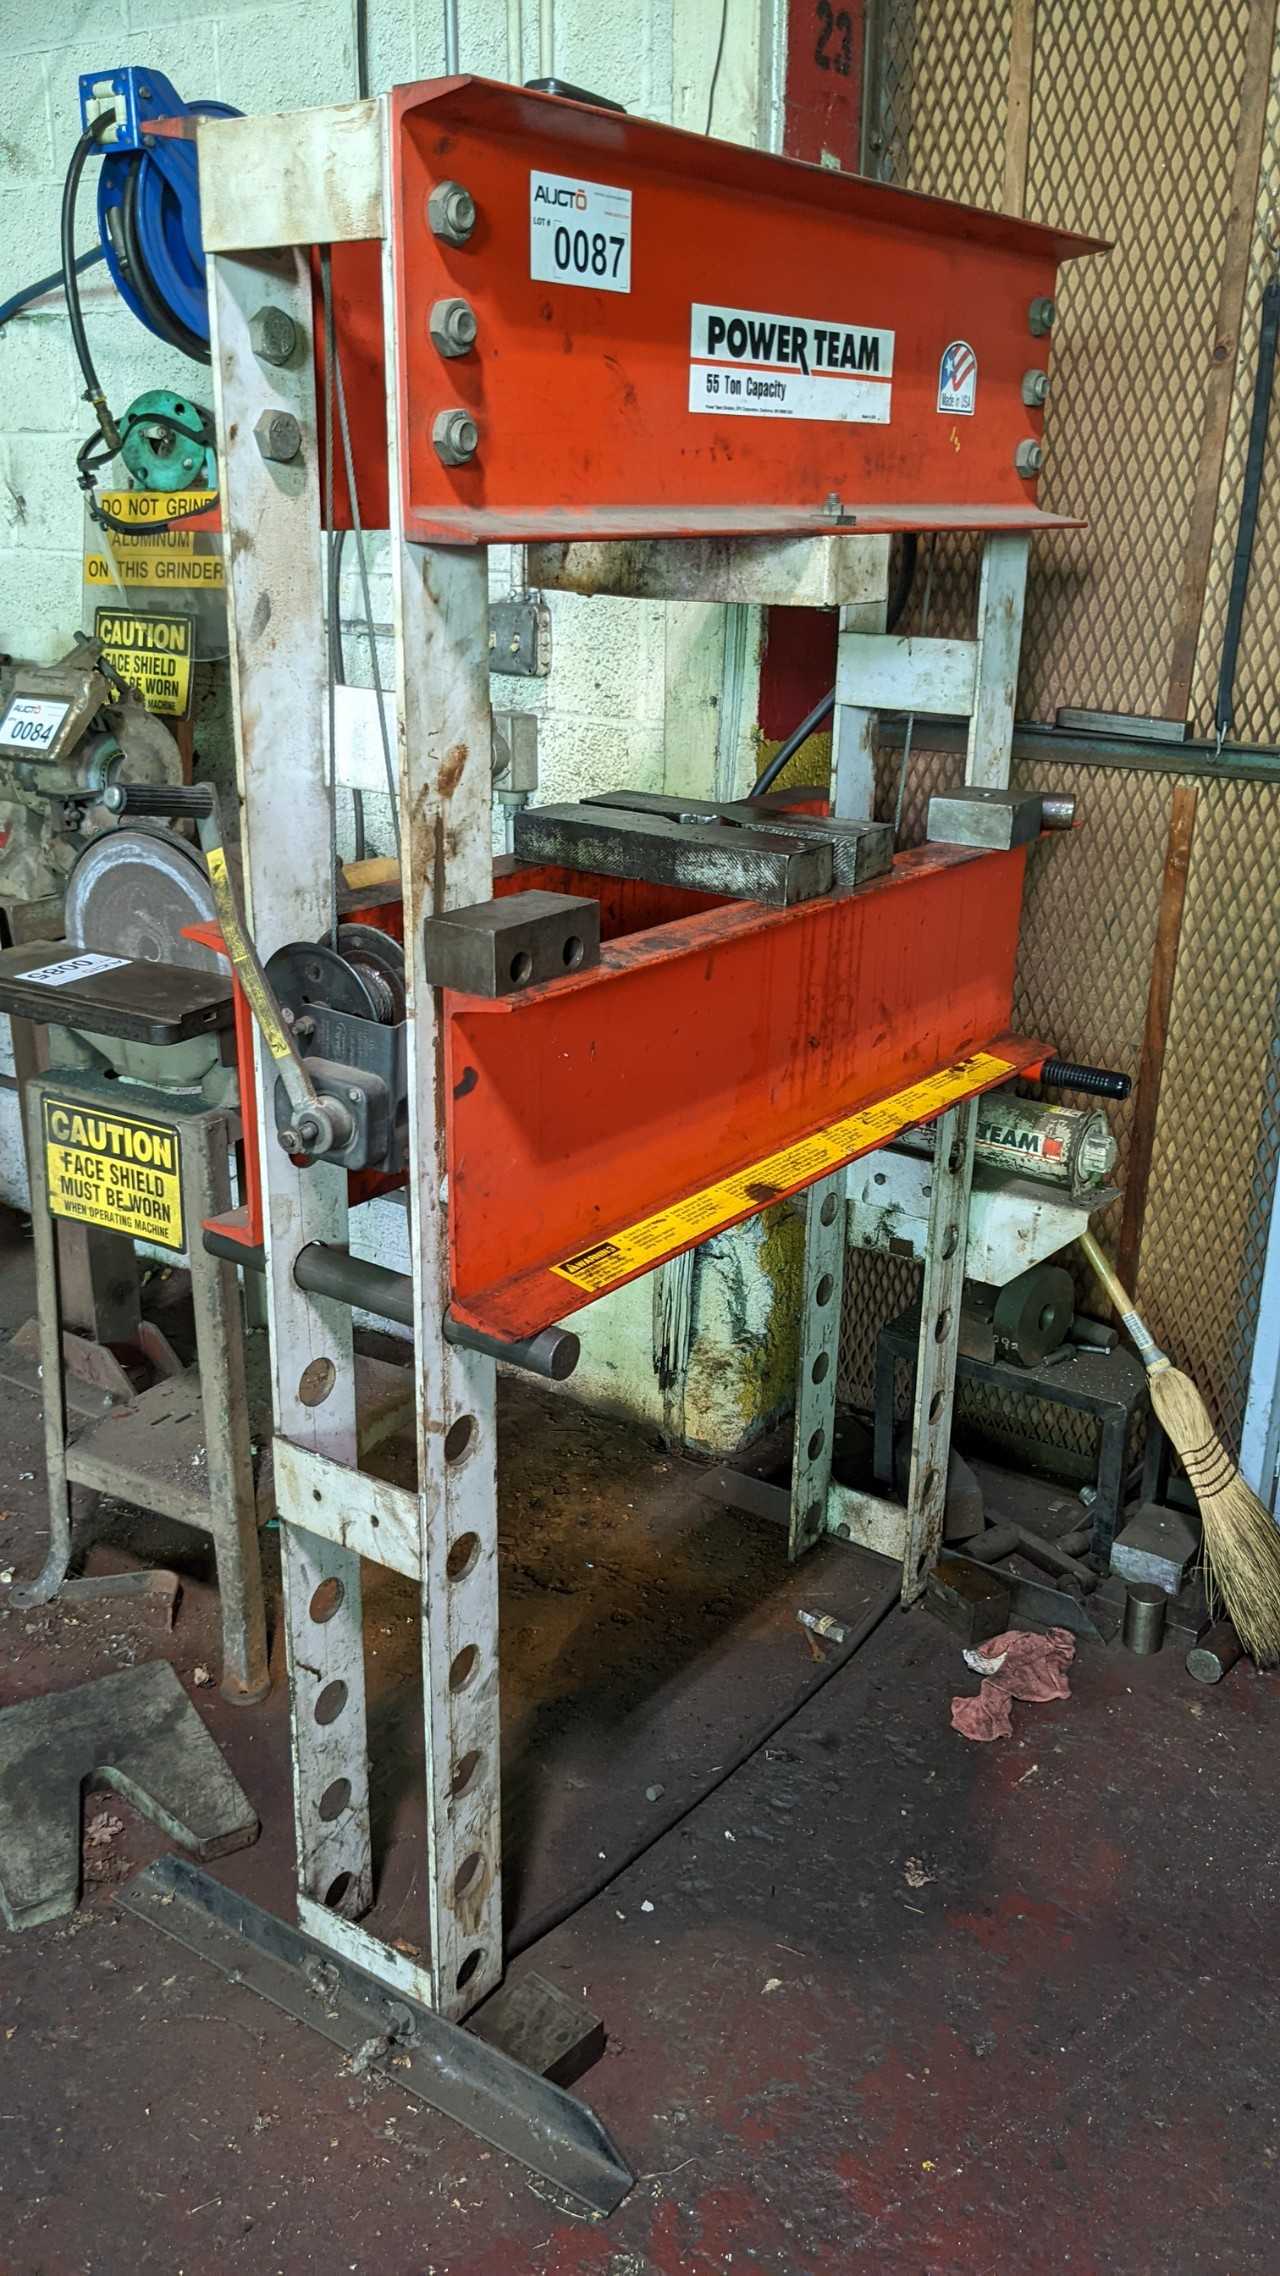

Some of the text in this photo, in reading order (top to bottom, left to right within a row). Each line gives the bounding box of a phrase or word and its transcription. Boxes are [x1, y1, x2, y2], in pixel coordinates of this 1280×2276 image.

[554, 226, 626, 278] 0087
[707, 315, 880, 376] POWER TEAM
[706, 373, 787, 402] 55 Ton Capacity
[102, 498, 122, 516] DO
[128, 498, 159, 516] NOT
[112, 531, 190, 548] ALUMINUM
[88, 560, 223, 580] ON THIS GRINDER
[101, 619, 185, 650] CAUTION
[133, 655, 176, 677] SHIELD
[145, 678, 179, 697] WORN
[11, 720, 54, 743] 0084
[27, 959, 93, 980] 0085
[51, 1110, 172, 1169] CAUTION
[977, 1121, 1039, 1152] TEAM
[62, 1151, 164, 1198] FACE SHIELD
[60, 1175, 171, 1223] MUST BE WORN
[64, 1200, 169, 1239] WHEN OPERATING MACHINE
